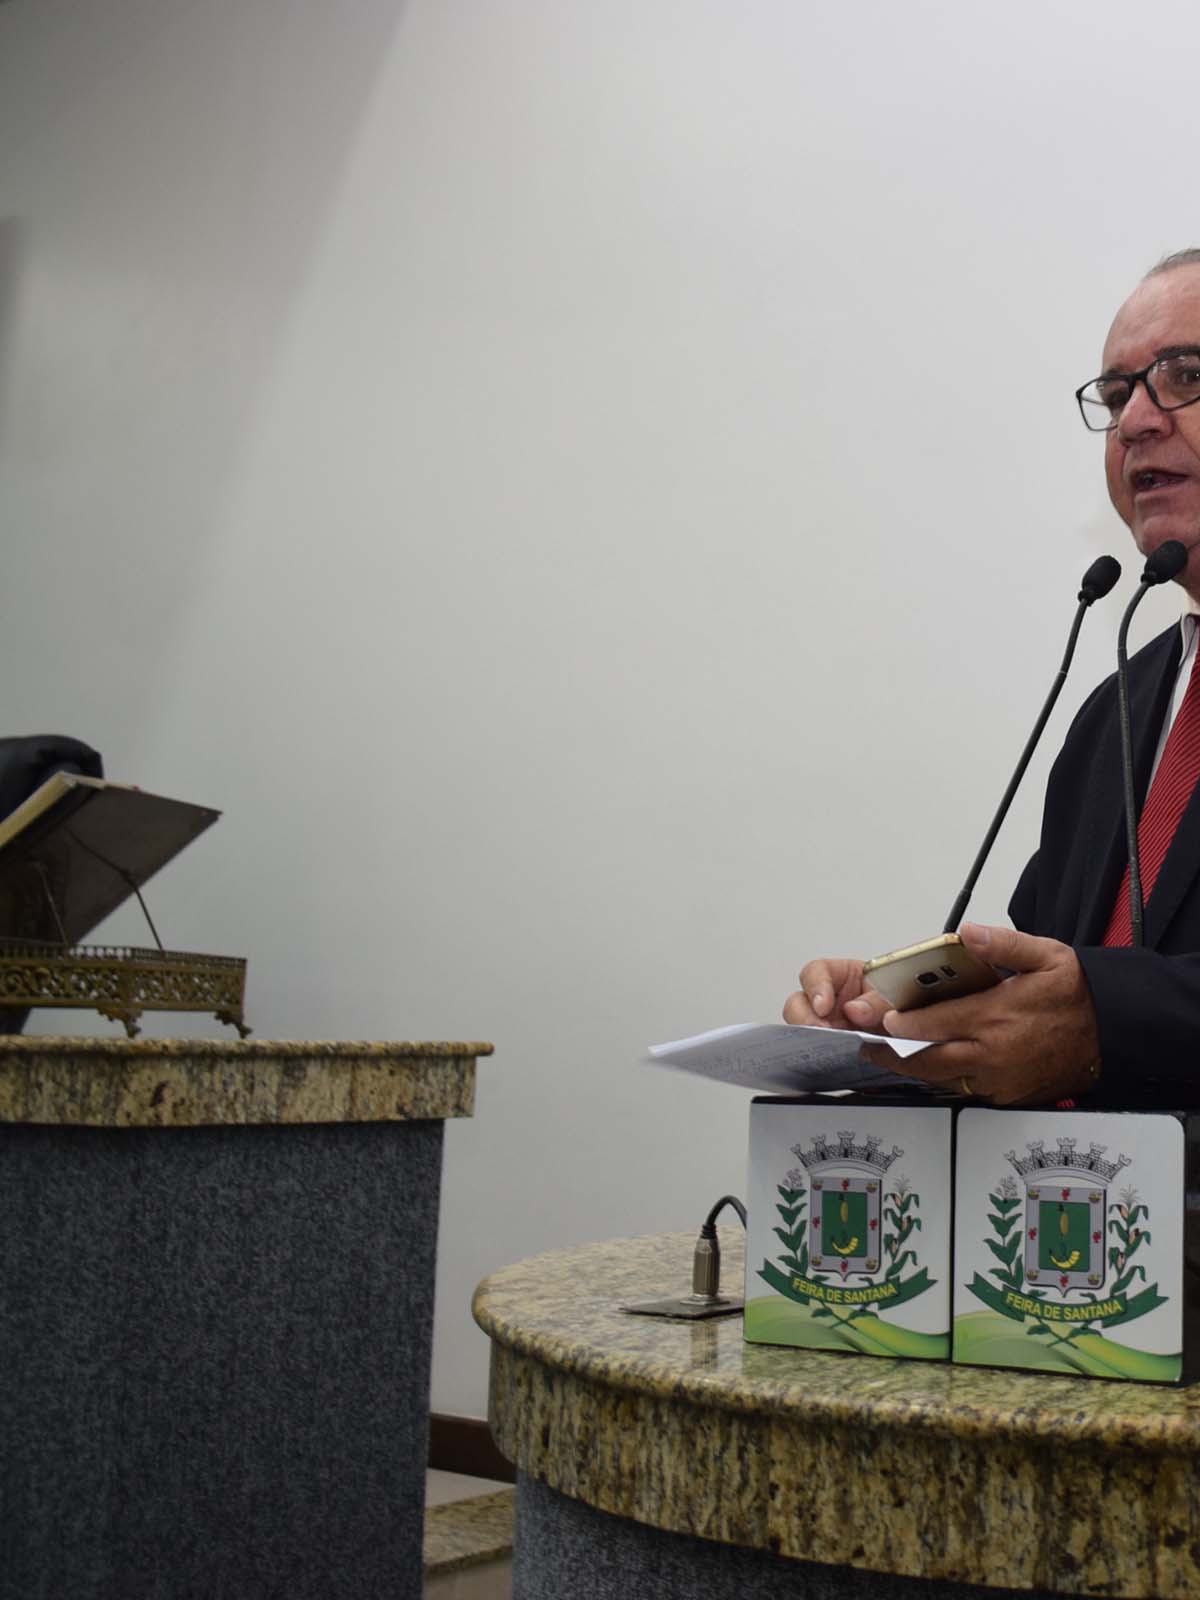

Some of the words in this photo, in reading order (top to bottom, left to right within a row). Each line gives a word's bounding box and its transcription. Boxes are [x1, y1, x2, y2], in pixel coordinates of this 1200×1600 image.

[792, 1277, 824, 1299] FEIRA
[826, 1289, 842, 1302] DE
[843, 1283, 897, 1304] SANTANA
[1006, 1292, 1041, 1314] FEIRA
[1043, 1304, 1061, 1318] DE
[1063, 1299, 1123, 1320] SANTANA
